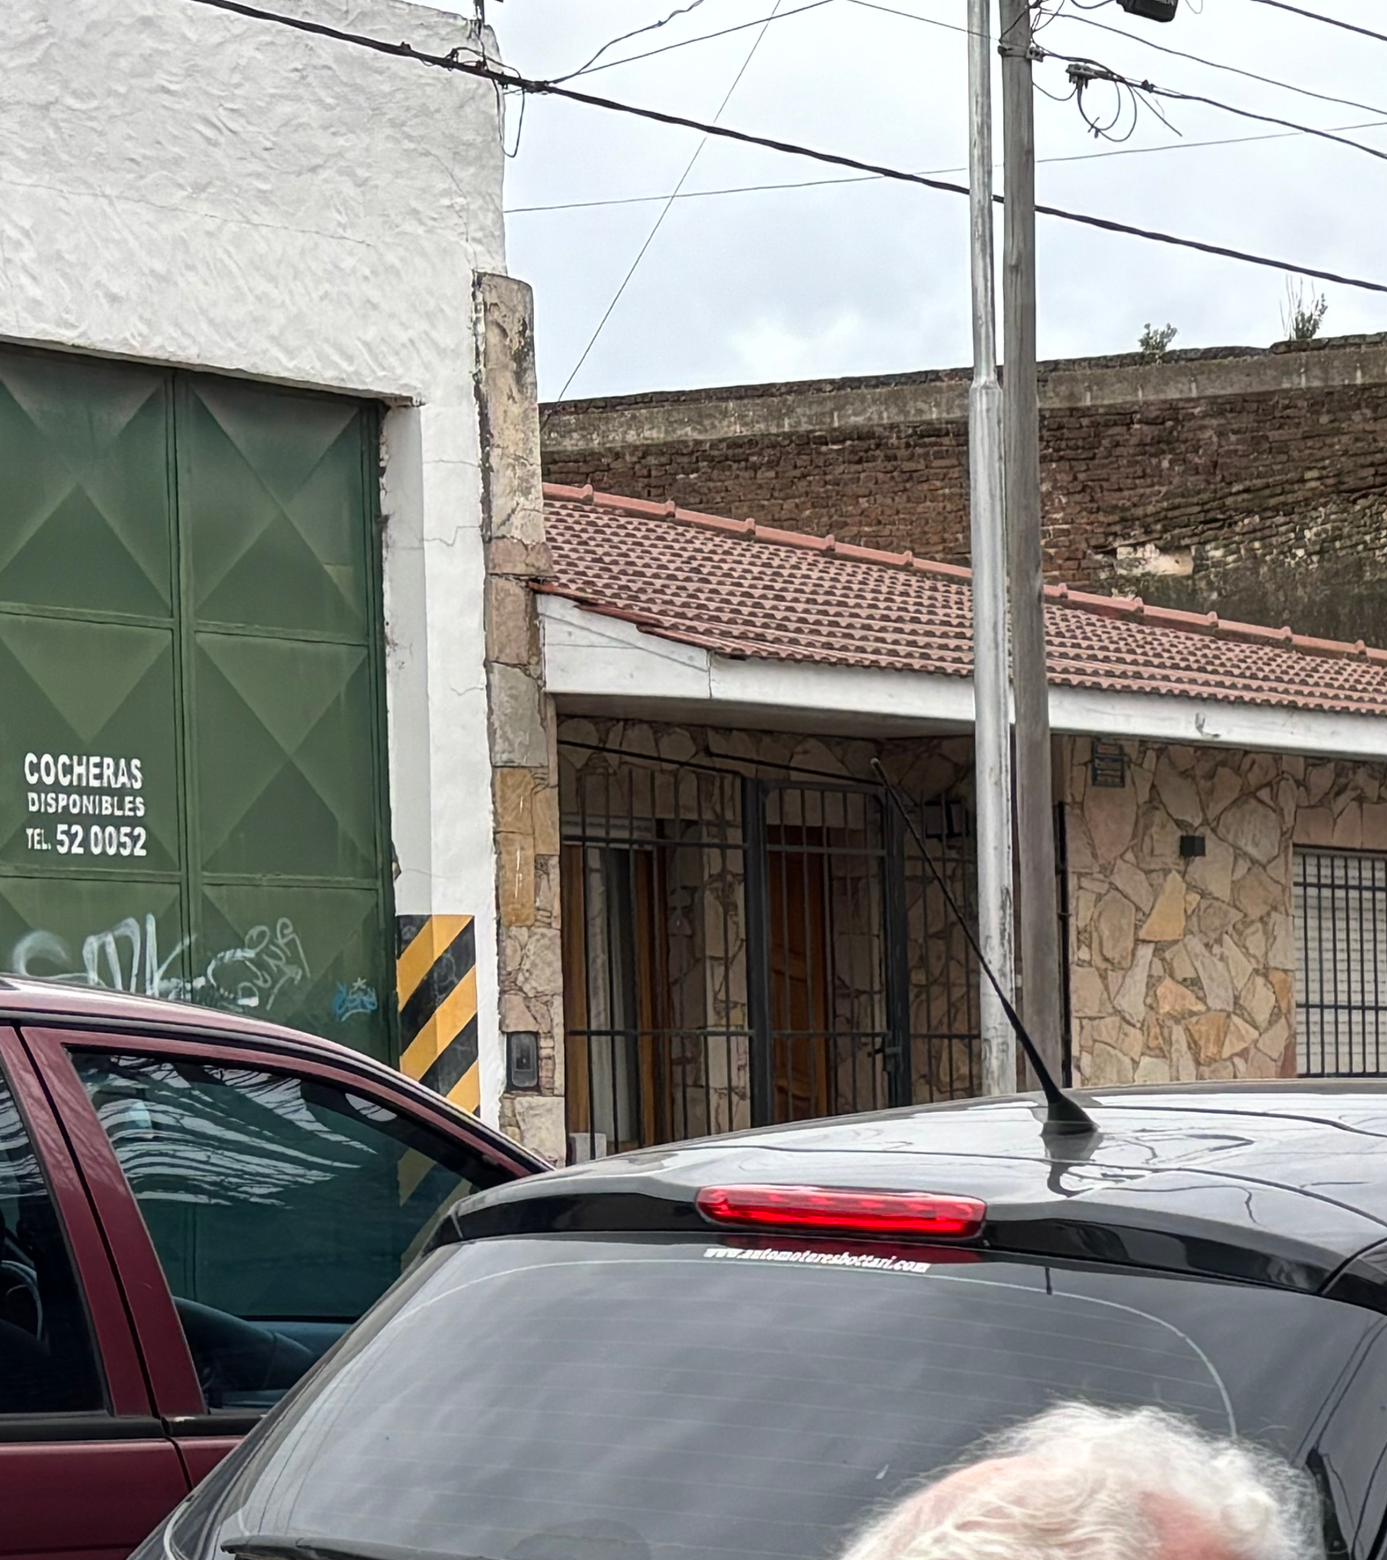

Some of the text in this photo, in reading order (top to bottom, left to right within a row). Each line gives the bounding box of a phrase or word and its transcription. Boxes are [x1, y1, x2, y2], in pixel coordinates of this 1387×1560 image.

[24, 752, 144, 789] COCHERAS
[27, 791, 146, 817] DISPONIBLES
[26, 823, 147, 857] TEL. 52 0052
